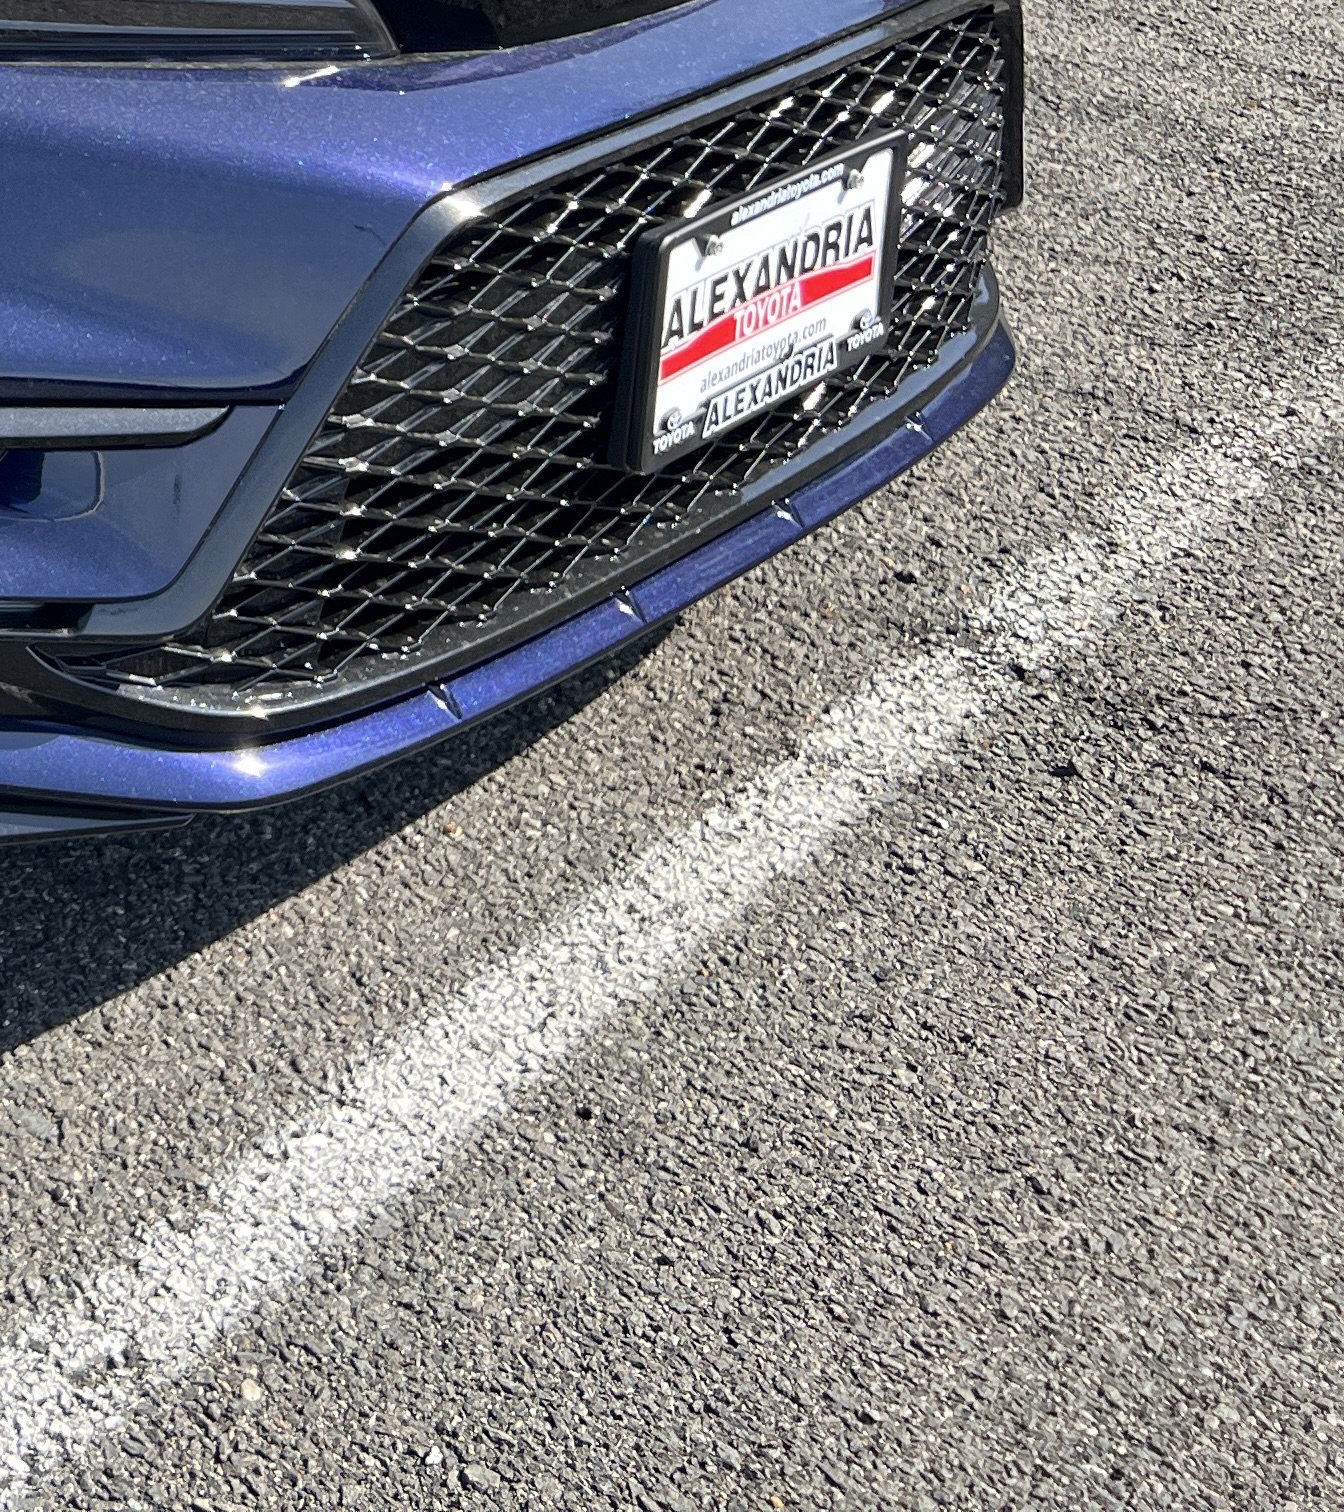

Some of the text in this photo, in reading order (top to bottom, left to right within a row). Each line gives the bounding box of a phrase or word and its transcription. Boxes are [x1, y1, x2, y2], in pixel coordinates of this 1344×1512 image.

[730, 162, 845, 227] alexandriatoyota.com
[662, 205, 875, 349] ALEXANDRIA
[733, 282, 804, 339] TOYOTA
[846, 322, 885, 352] TOYOTA
[699, 316, 827, 393] alexandriatoyota.com
[706, 340, 837, 436] ALEXANDRIA
[652, 422, 695, 455] TOYOTA
